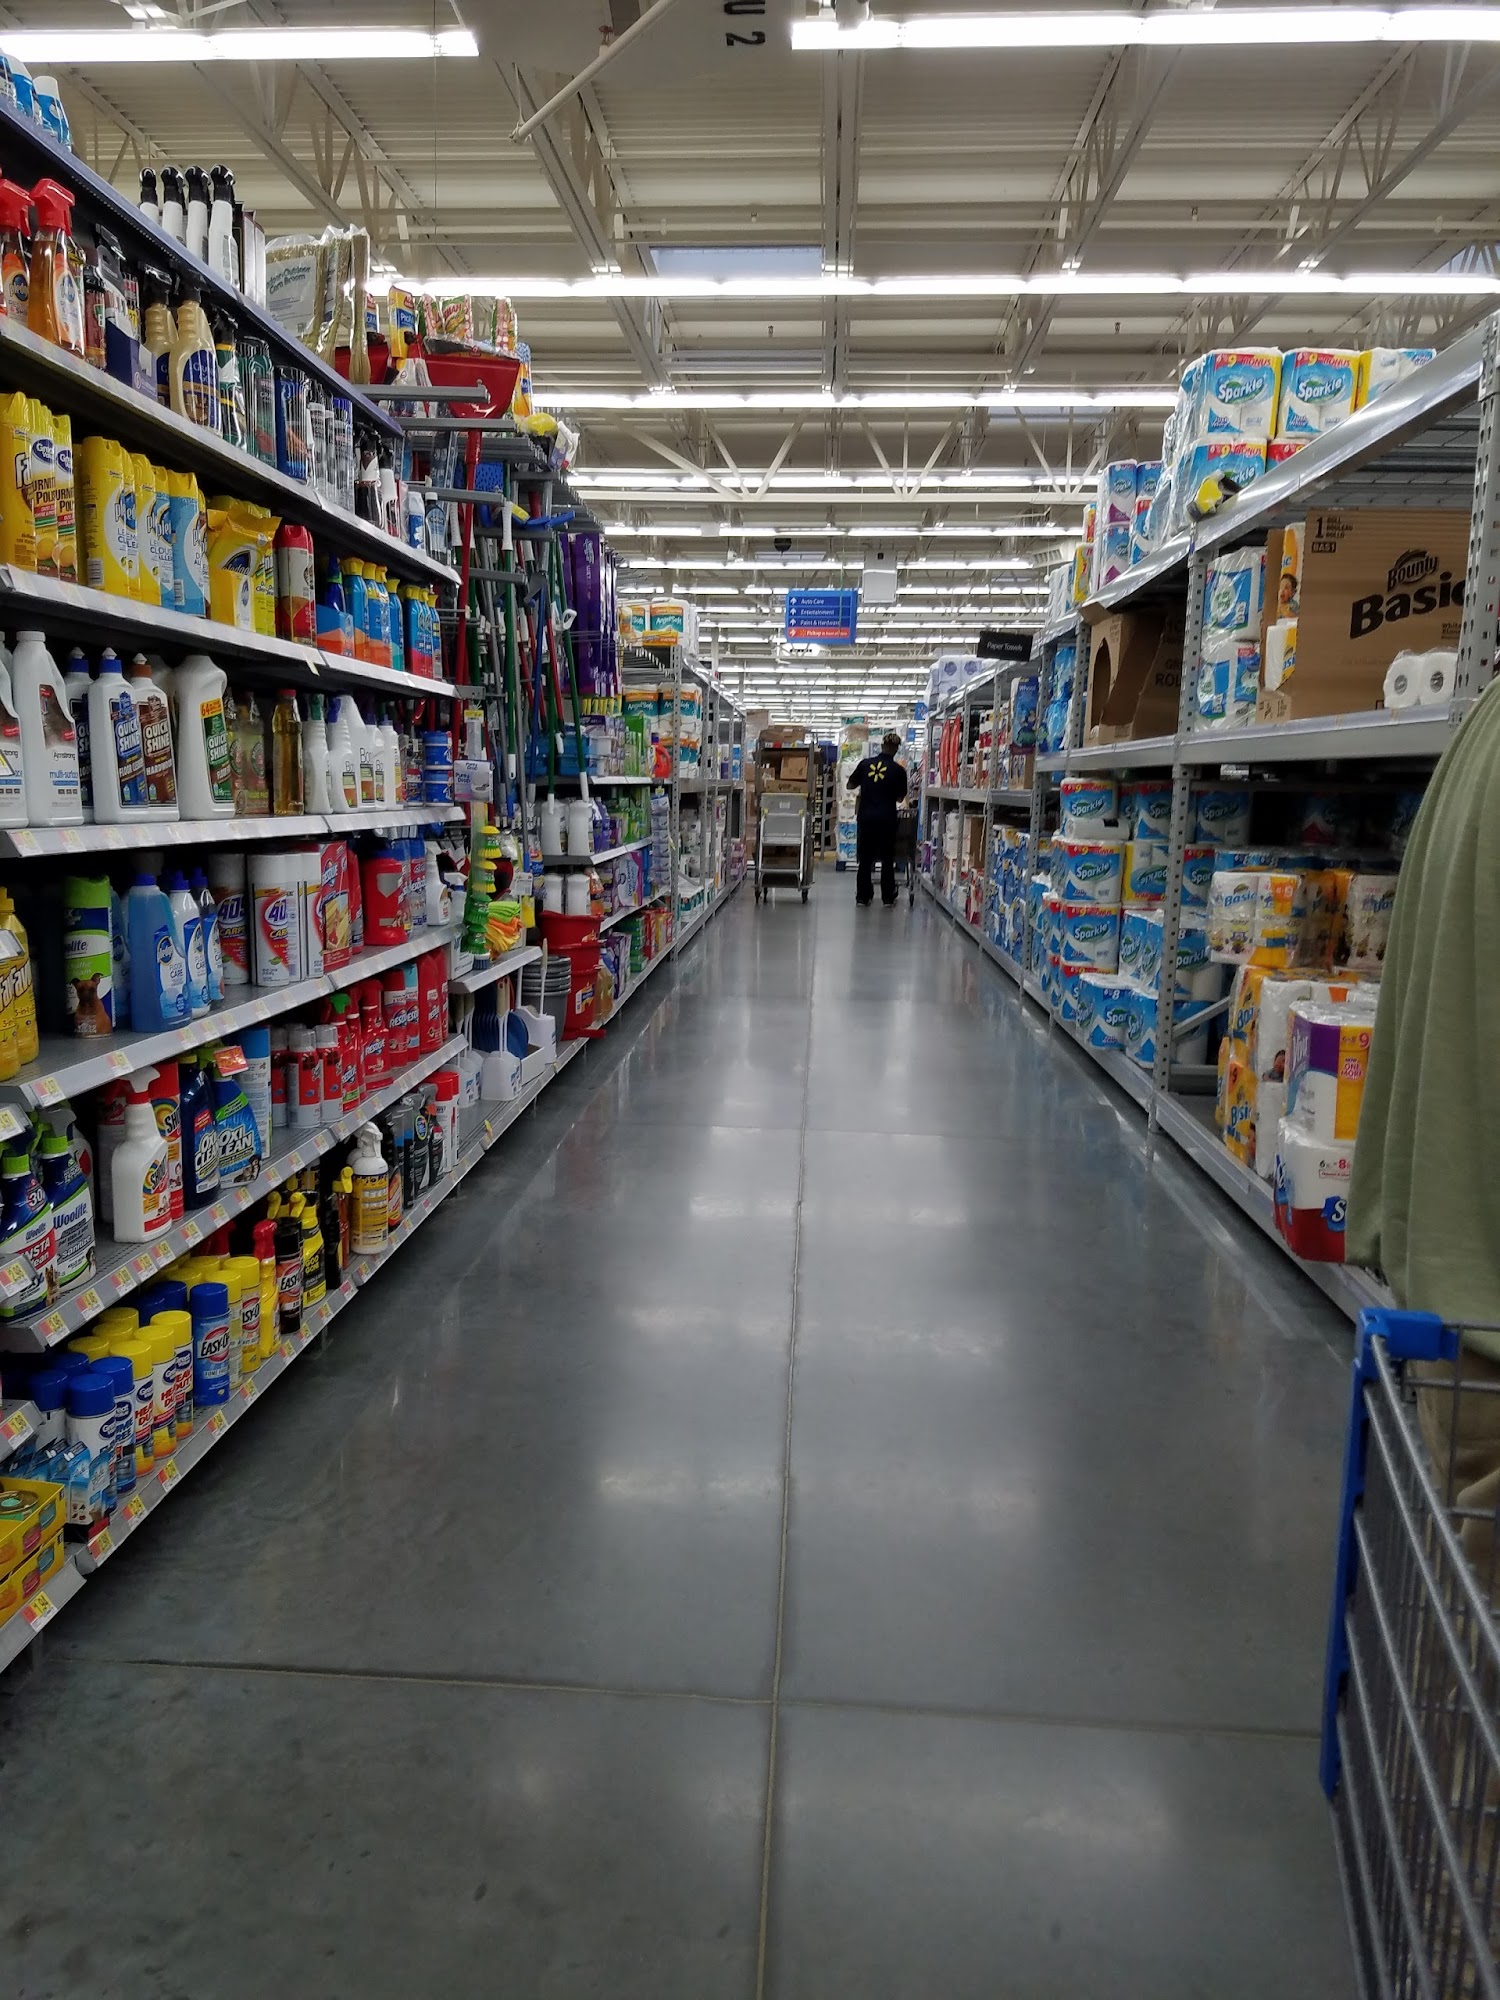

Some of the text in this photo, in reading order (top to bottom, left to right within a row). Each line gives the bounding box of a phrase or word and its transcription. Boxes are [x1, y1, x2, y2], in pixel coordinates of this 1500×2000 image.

[725, 31, 766, 46] 2
[269, 274, 306, 294] Corn Broom
[1228, 355, 1237, 367] 9
[1308, 353, 1318, 366] 9
[1218, 378, 1263, 403] Sparkle
[1298, 378, 1342, 402] Sparkle
[1315, 516, 1324, 538] 1
[1387, 555, 1439, 592] Bounty
[987, 641, 1023, 652] Paper Towels
[201, 703, 210, 716] 64
[118, 718, 137, 736] QUICK
[146, 721, 168, 739] QUICK
[120, 733, 140, 752] SHINE
[147, 735, 169, 753] SHINE
[209, 732, 226, 748] QUICK
[210, 743, 228, 761] SHINE
[1072, 796, 1103, 816] Sparkle
[1076, 862, 1109, 880] Sparkle
[268, 899, 287, 922] 40
[1074, 924, 1108, 940] Sparkle
[170, 968, 184, 979] CARE
[1112, 989, 1120, 1000] 8
[1359, 1032, 1370, 1048] 9
[219, 1124, 245, 1147] OXI
[219, 1134, 253, 1158] LEAN
[195, 1141, 218, 1171] CLEA
[54, 1203, 88, 1230] Woolite
[62, 1235, 92, 1257] sanitize
